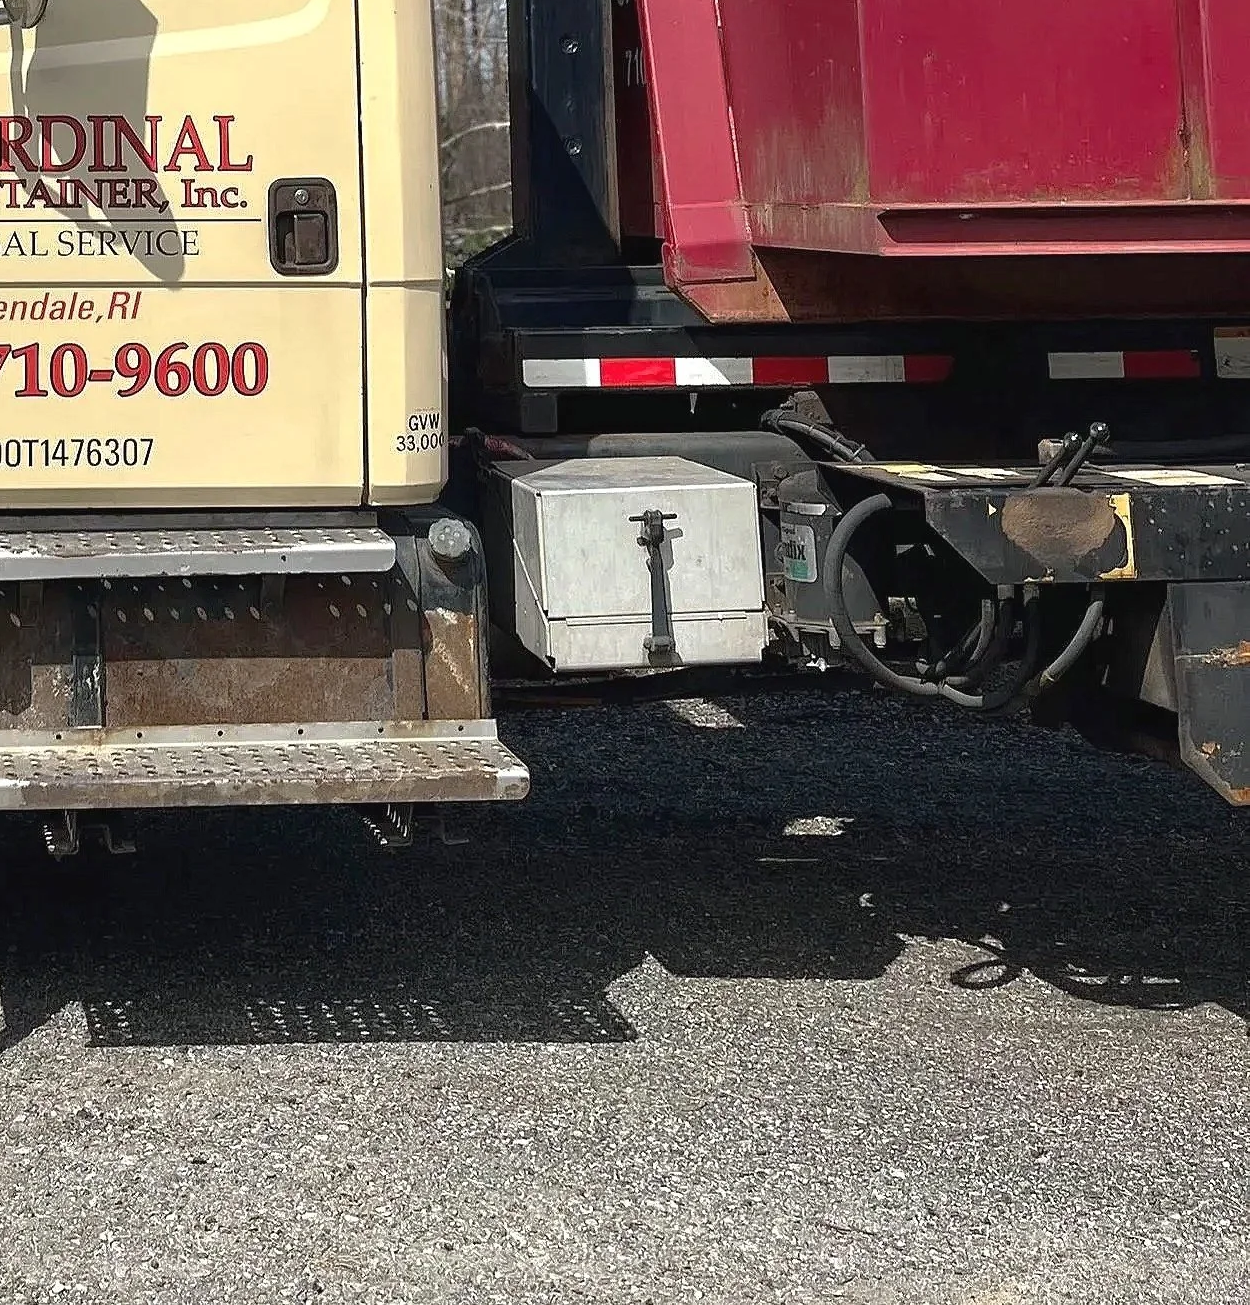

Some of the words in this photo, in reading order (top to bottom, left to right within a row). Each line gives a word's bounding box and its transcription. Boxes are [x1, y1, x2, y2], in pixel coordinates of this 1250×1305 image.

[181, 179, 249, 209] Inc.
[57, 228, 200, 259] SERVICE
[409, 413, 440, 431] GVW
[396, 432, 445, 453] 33,000
